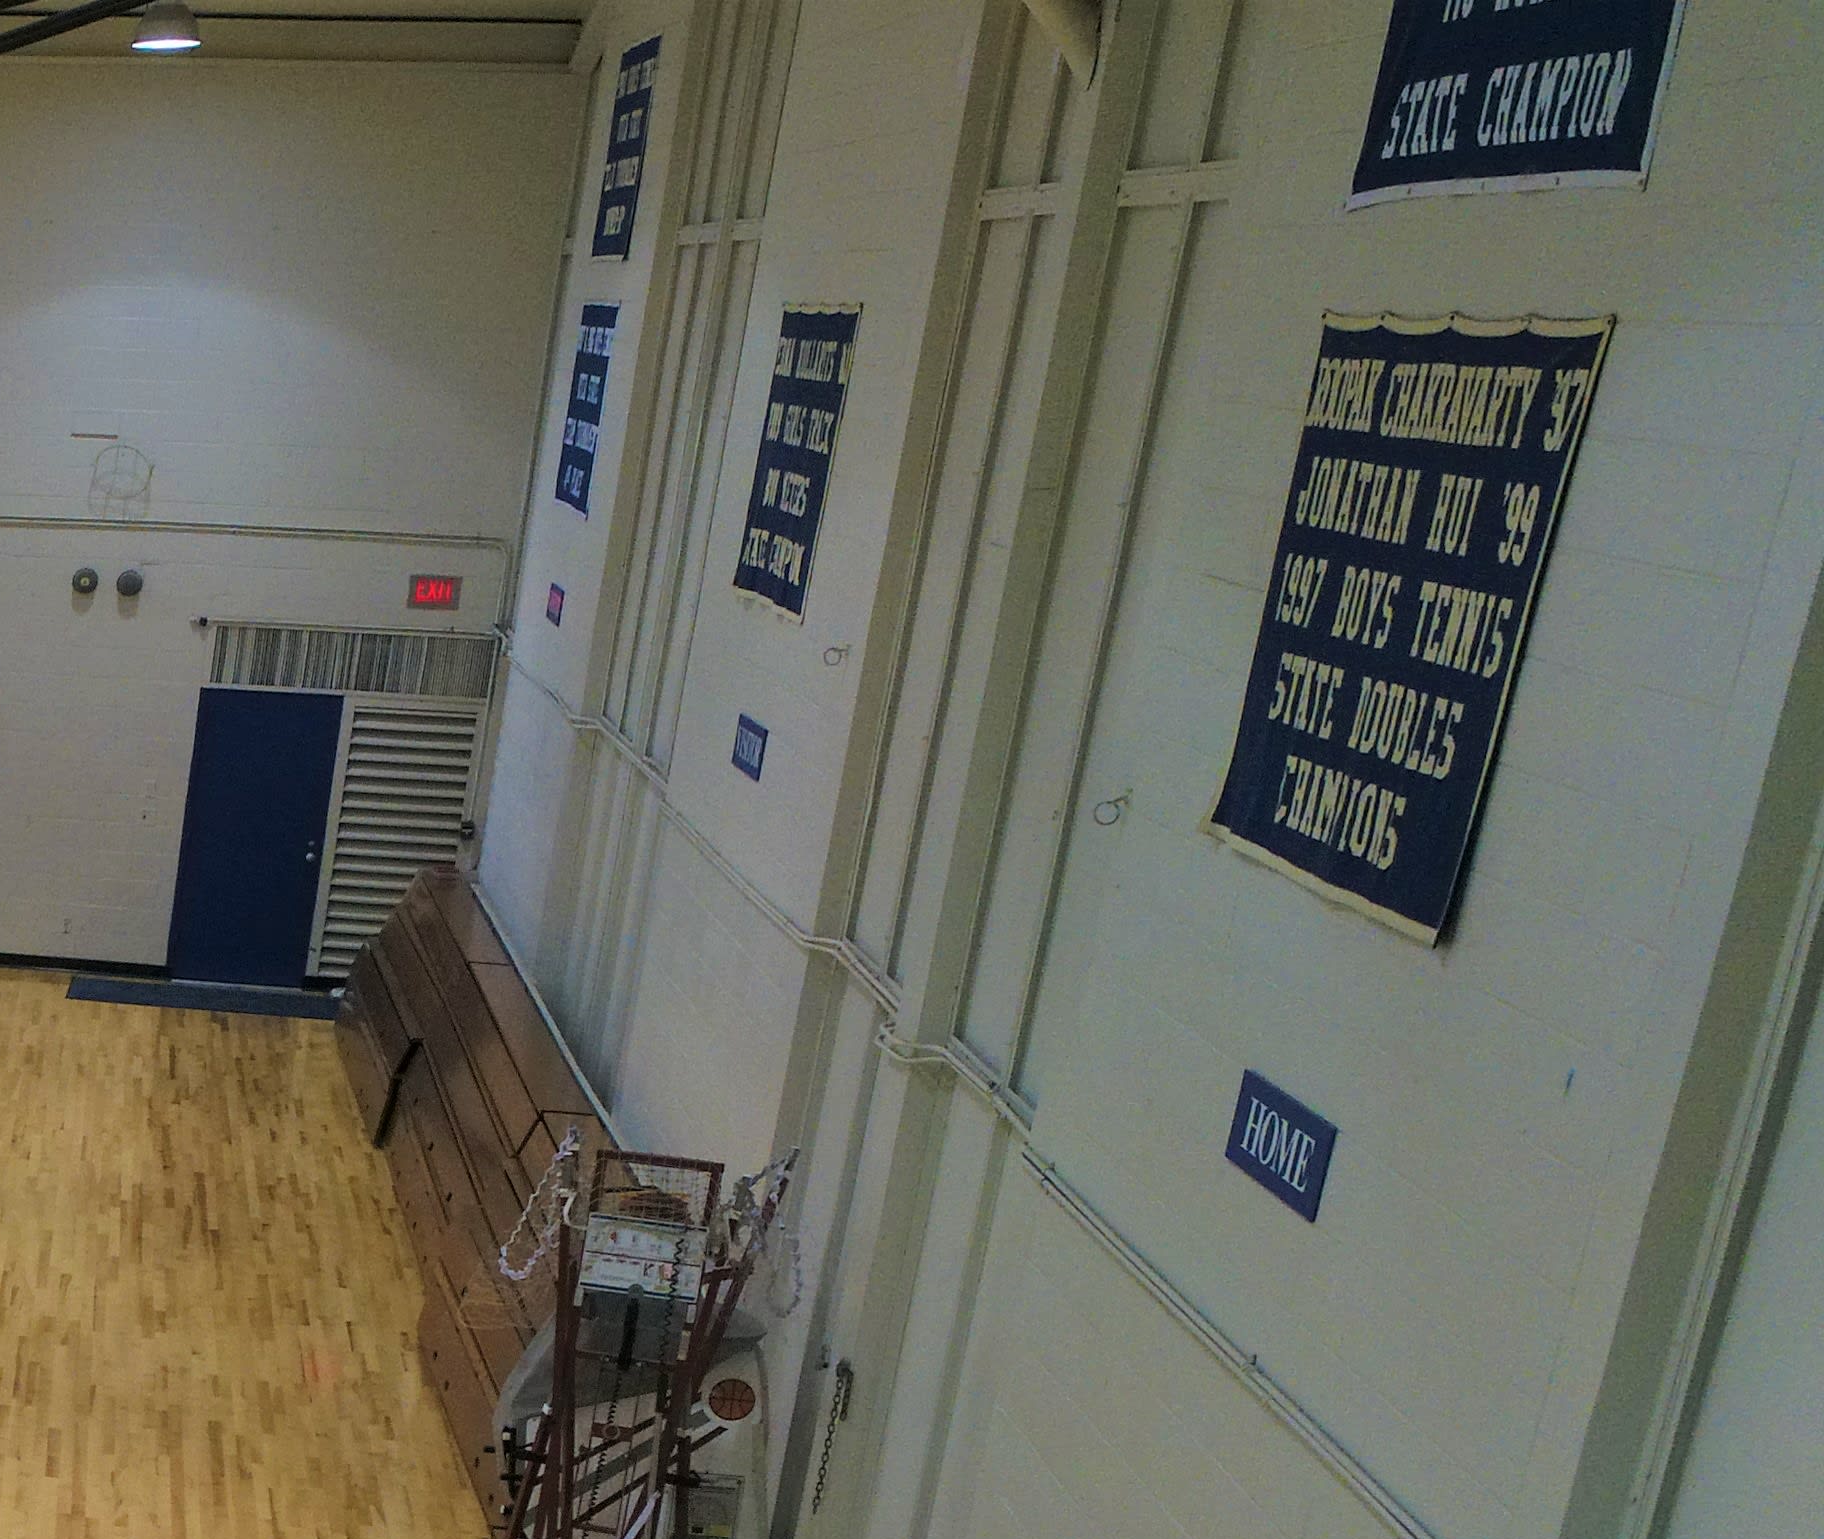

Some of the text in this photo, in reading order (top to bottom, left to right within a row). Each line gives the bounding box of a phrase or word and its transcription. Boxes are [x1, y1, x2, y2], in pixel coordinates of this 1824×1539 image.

[1381, 48, 1633, 160] STATE CHAMPION
[1295, 456, 1541, 567] JONATHAN HUI '99
[415, 579, 452, 603] EXIT
[1275, 553, 1513, 679] 1997 BOYS TENNIS
[1268, 652, 1464, 780] STATE DOUBLES
[1274, 754, 1406, 871] CHAMPIONS
[1240, 1097, 1316, 1192] HOME
